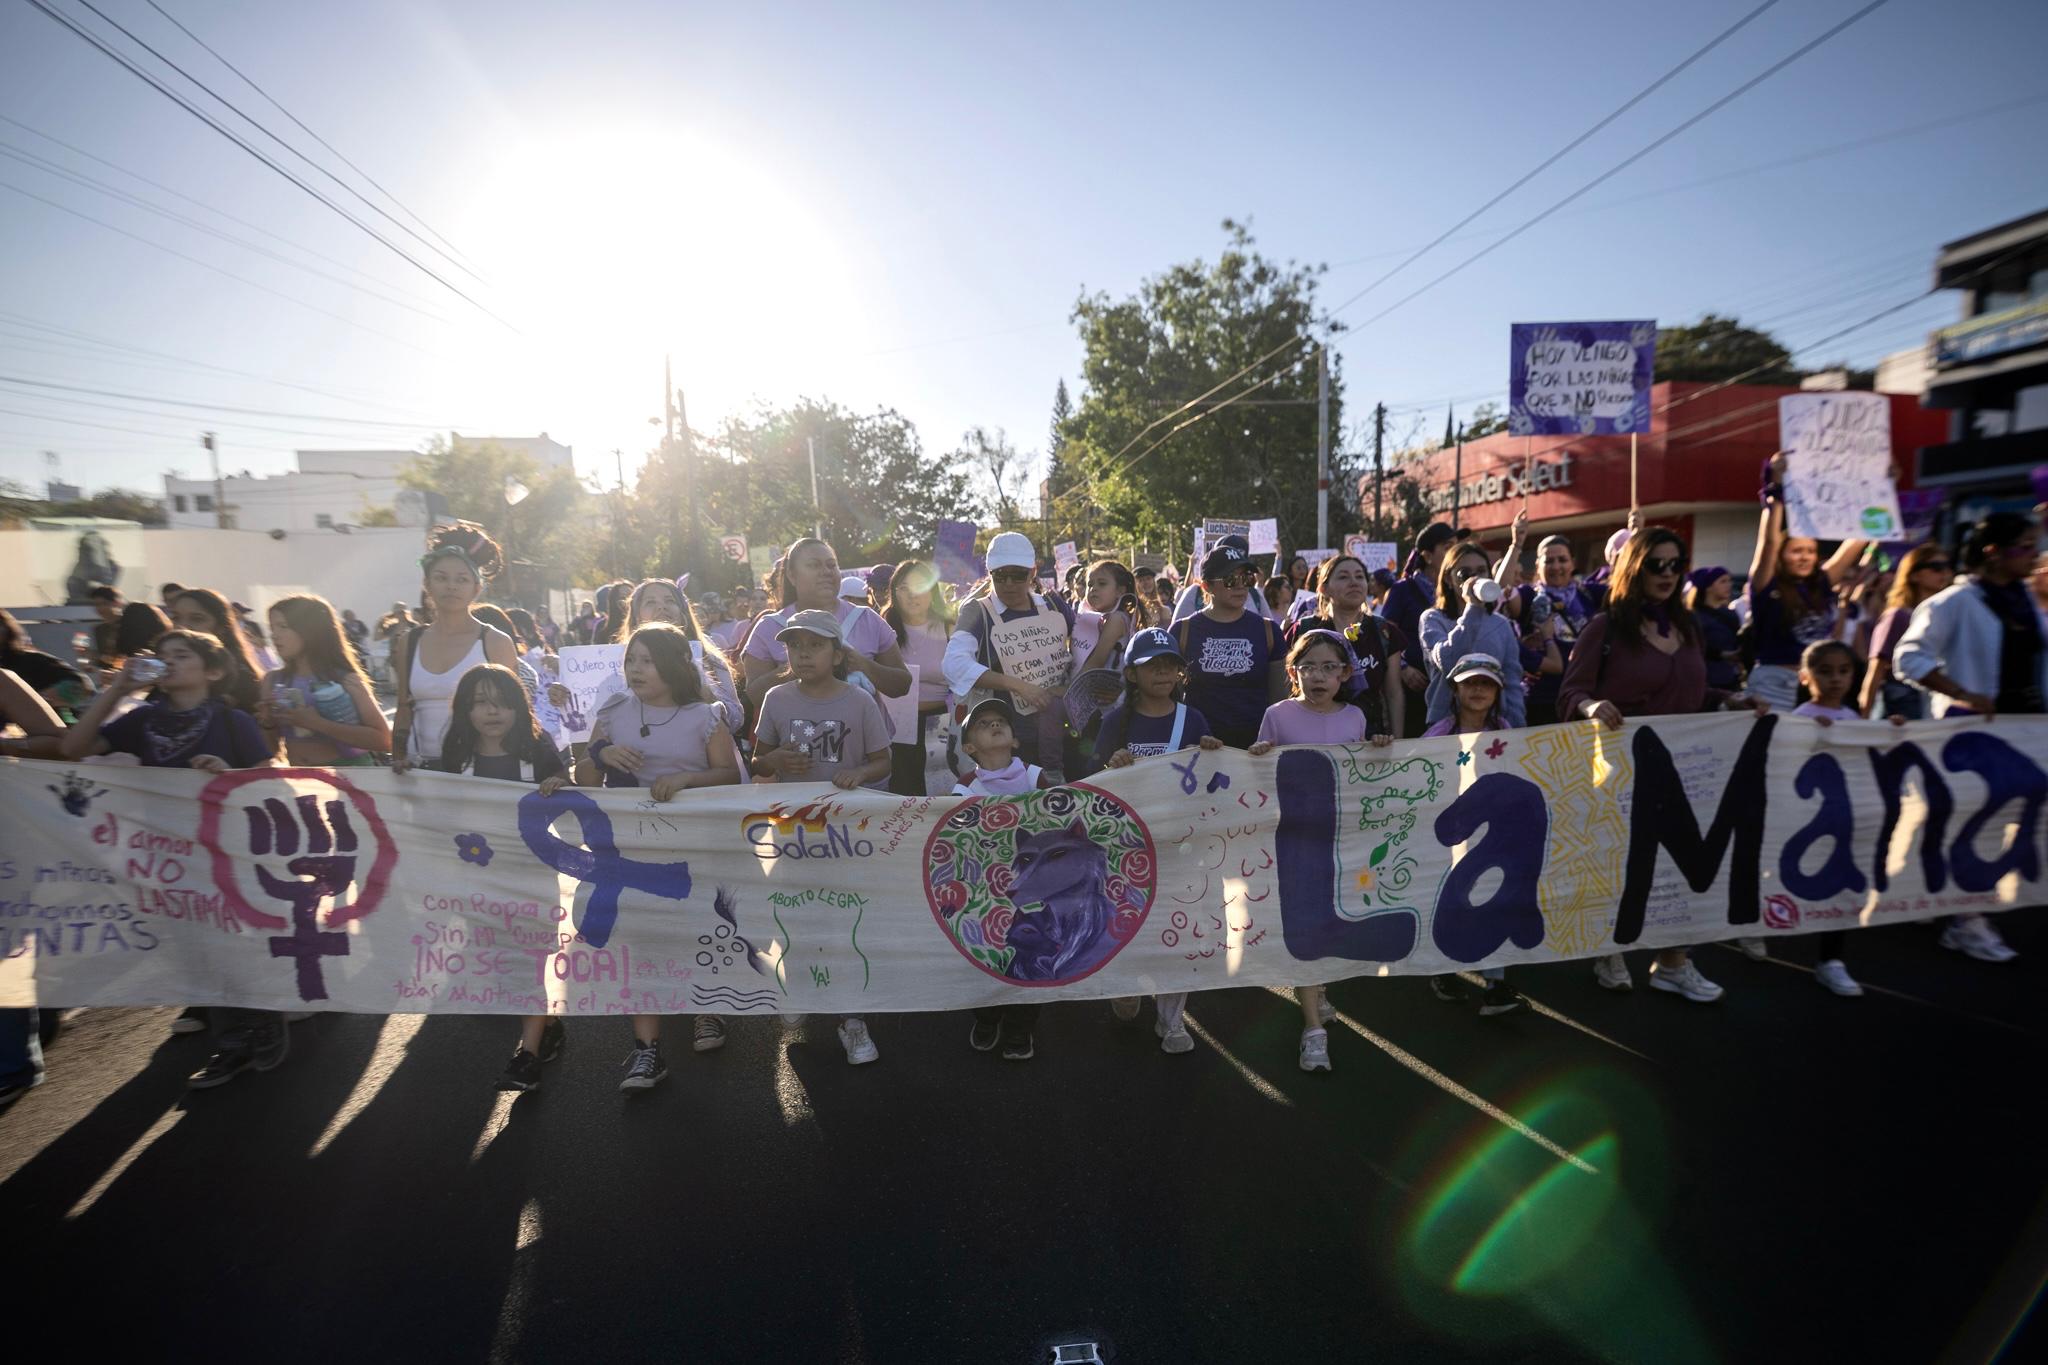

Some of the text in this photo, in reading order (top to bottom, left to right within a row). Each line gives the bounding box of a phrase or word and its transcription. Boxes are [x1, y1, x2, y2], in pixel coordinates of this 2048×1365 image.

[1531, 344, 1629, 366] HOY VENGO
[1527, 370, 1562, 389] POR
[1567, 370, 1593, 387] LAS
[1527, 393, 1557, 408] QUE
[1574, 388, 1597, 409] NO
[1506, 450, 1573, 498] Select
[1206, 523, 1228, 534] Lucha
[1020, 626, 1050, 639] NIÑAS
[1151, 630, 1169, 645] LA
[1000, 645, 1015, 657] NO
[1017, 641, 1032, 653] SE
[567, 657, 622, 676] Quiero qu
[1011, 662, 1024, 675] DE
[880, 794, 917, 834] Mujeres
[91, 812, 194, 856] el amor
[880, 819, 913, 856] fuertes
[911, 814, 924, 823] y
[1275, 749, 1548, 963] La
[127, 852, 185, 884] NO
[768, 888, 869, 909] ABORTO LEGAL
[138, 885, 242, 934] LASTIMA
[470, 893, 538, 929] Ropa
[550, 905, 567, 922] o
[472, 951, 513, 976] SE
[522, 944, 632, 1000] TOCA!
[578, 991, 596, 1010] el
